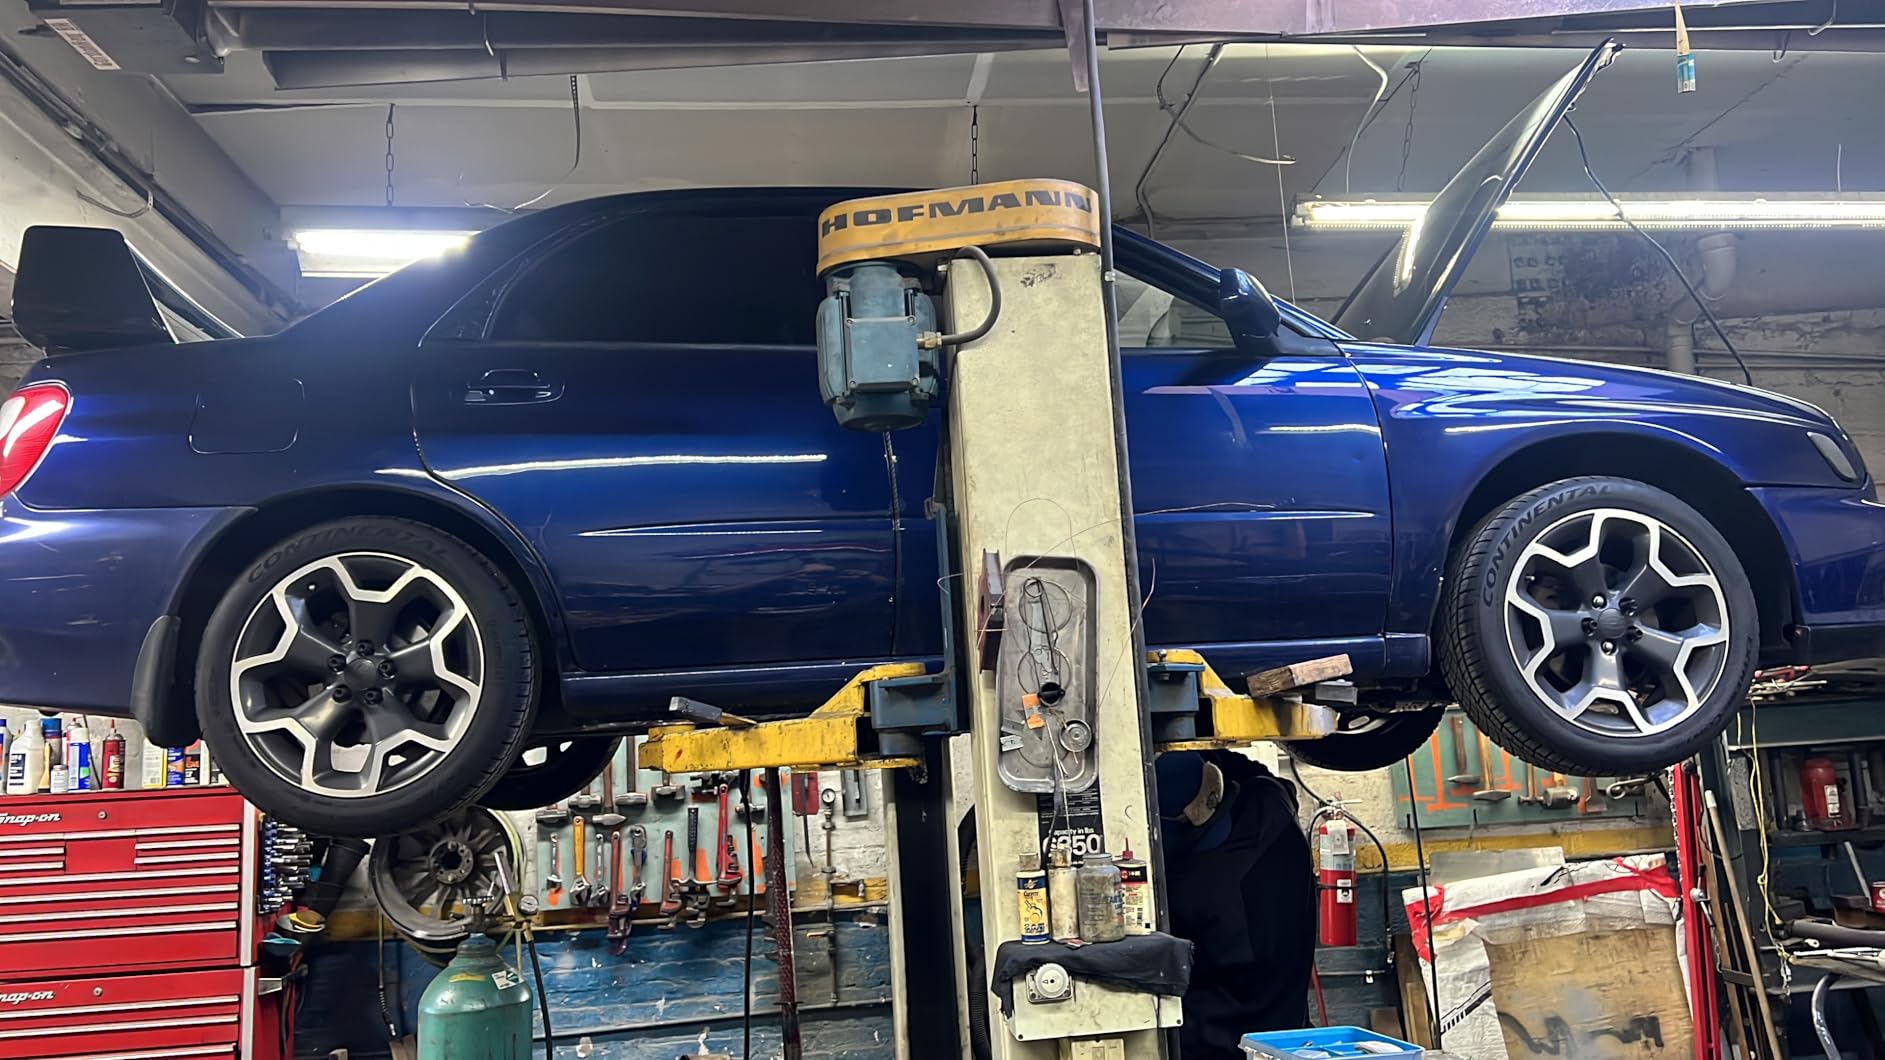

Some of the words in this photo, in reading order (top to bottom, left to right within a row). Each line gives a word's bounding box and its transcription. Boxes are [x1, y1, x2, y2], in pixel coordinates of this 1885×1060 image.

[822, 190, 1093, 238] HOFMANN
[249, 526, 448, 584] CONTINENTAL
[1482, 484, 1609, 607] CONTINENTAL
[0, 990, 54, 1005] nap-on
